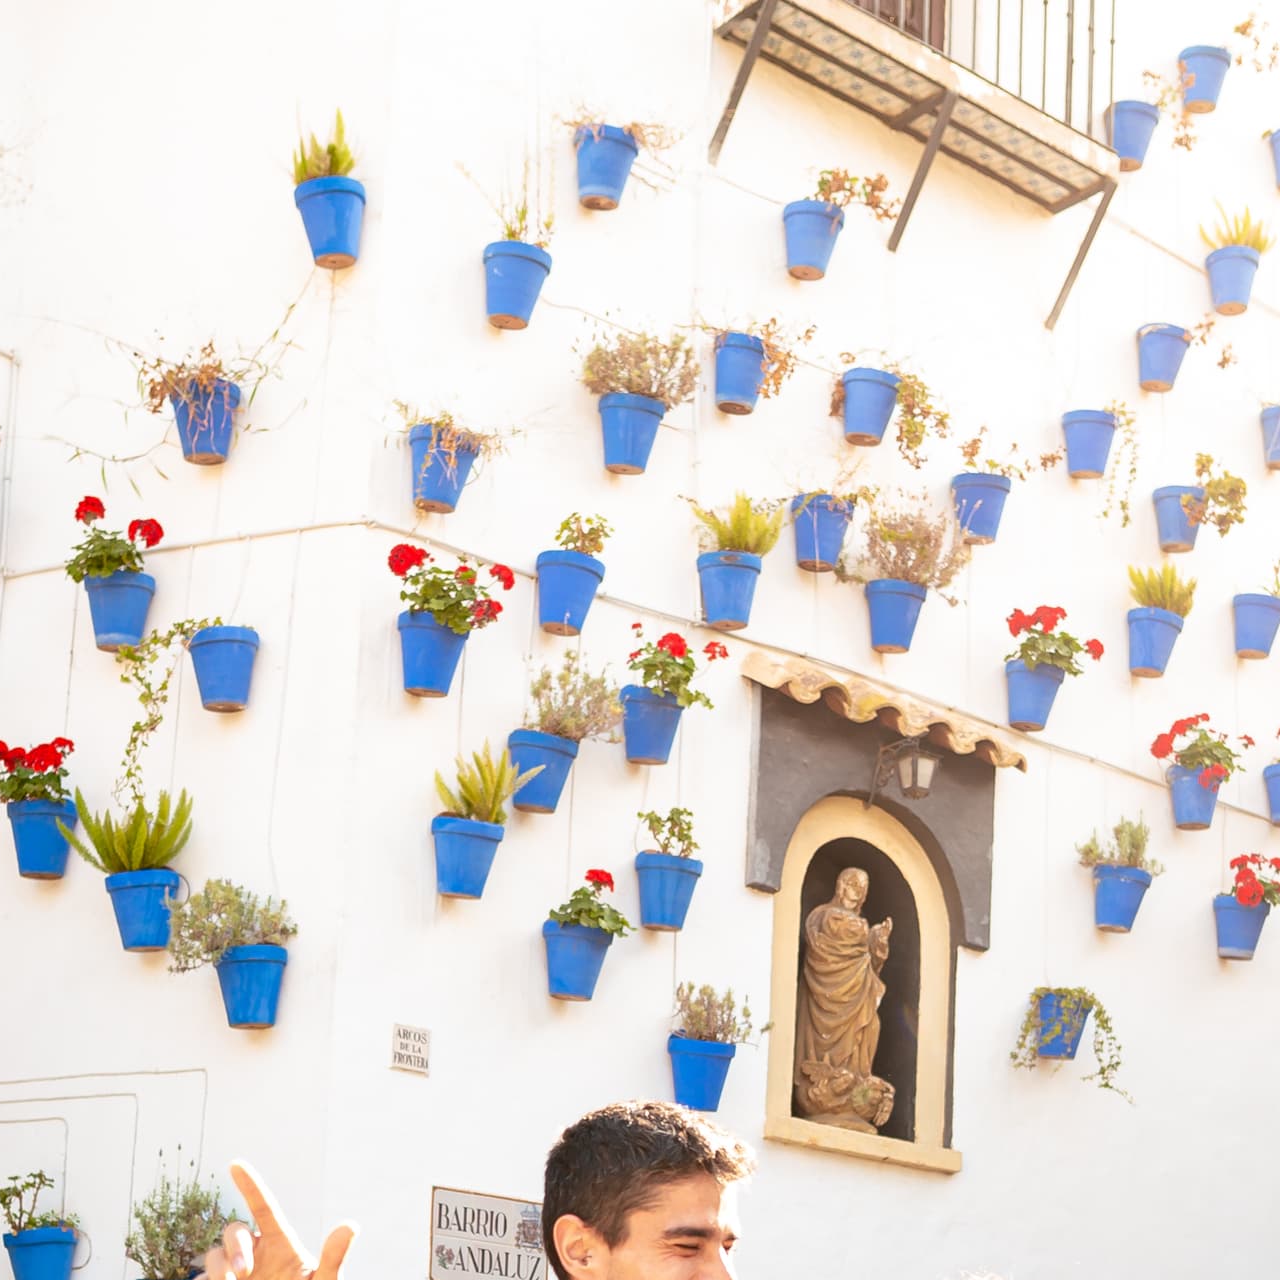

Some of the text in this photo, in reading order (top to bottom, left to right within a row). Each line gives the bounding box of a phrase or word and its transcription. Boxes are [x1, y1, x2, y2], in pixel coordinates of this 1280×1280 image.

[397, 1028, 428, 1045] ARCOS
[400, 1041, 422, 1054] DE LA
[437, 1202, 508, 1238] BARRIO
